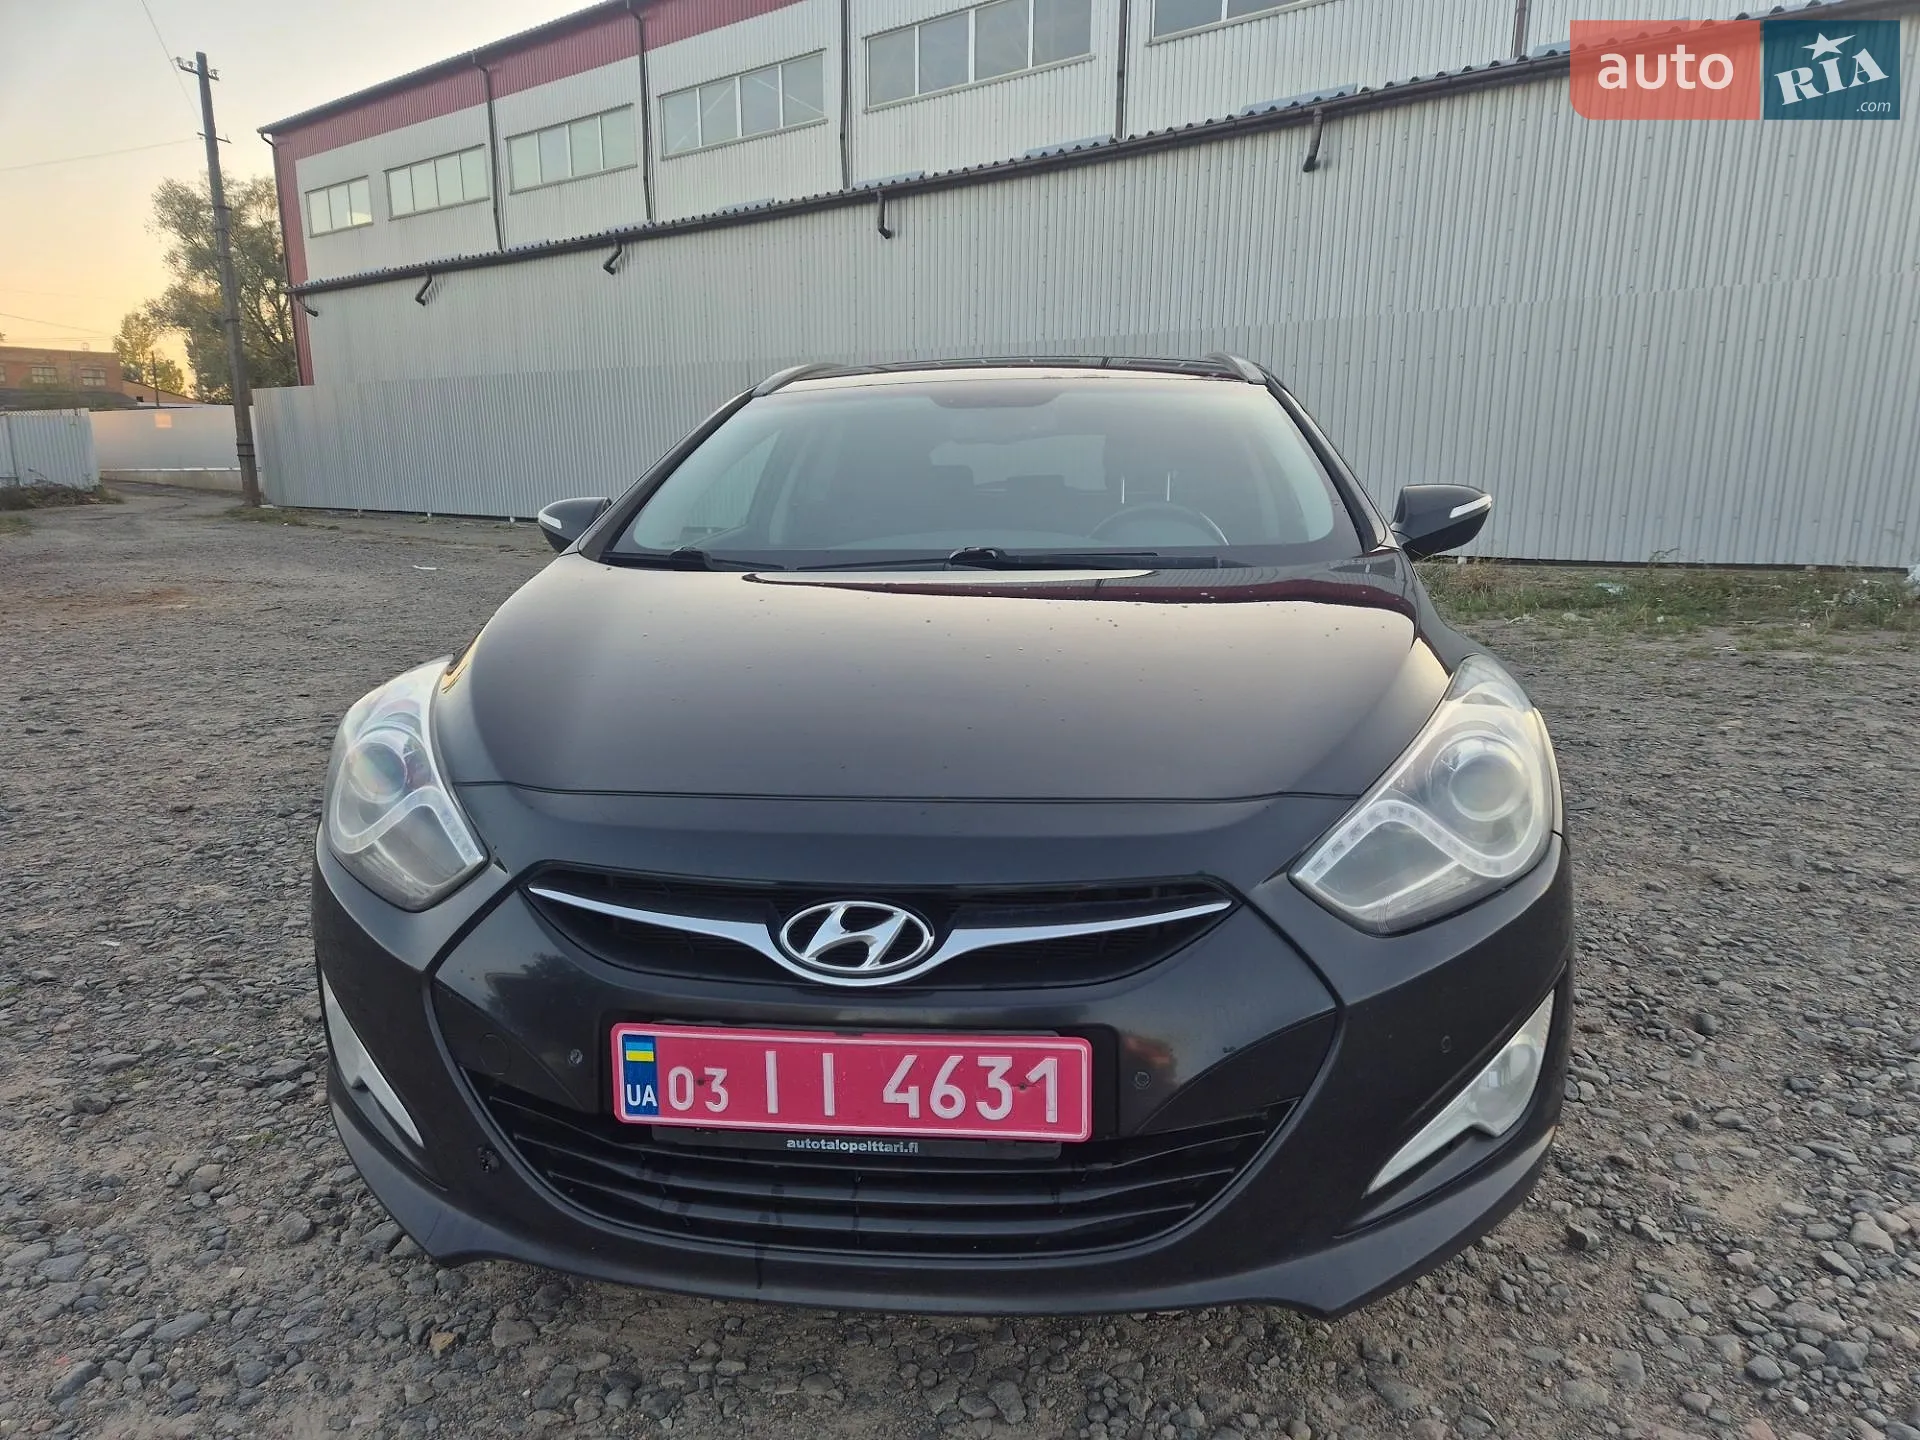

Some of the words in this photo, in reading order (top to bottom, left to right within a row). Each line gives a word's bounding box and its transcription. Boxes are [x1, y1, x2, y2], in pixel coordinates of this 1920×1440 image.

[626, 1084, 658, 1106] UA
[667, 1066, 729, 1113] 03
[882, 1054, 1058, 1123] 4631
